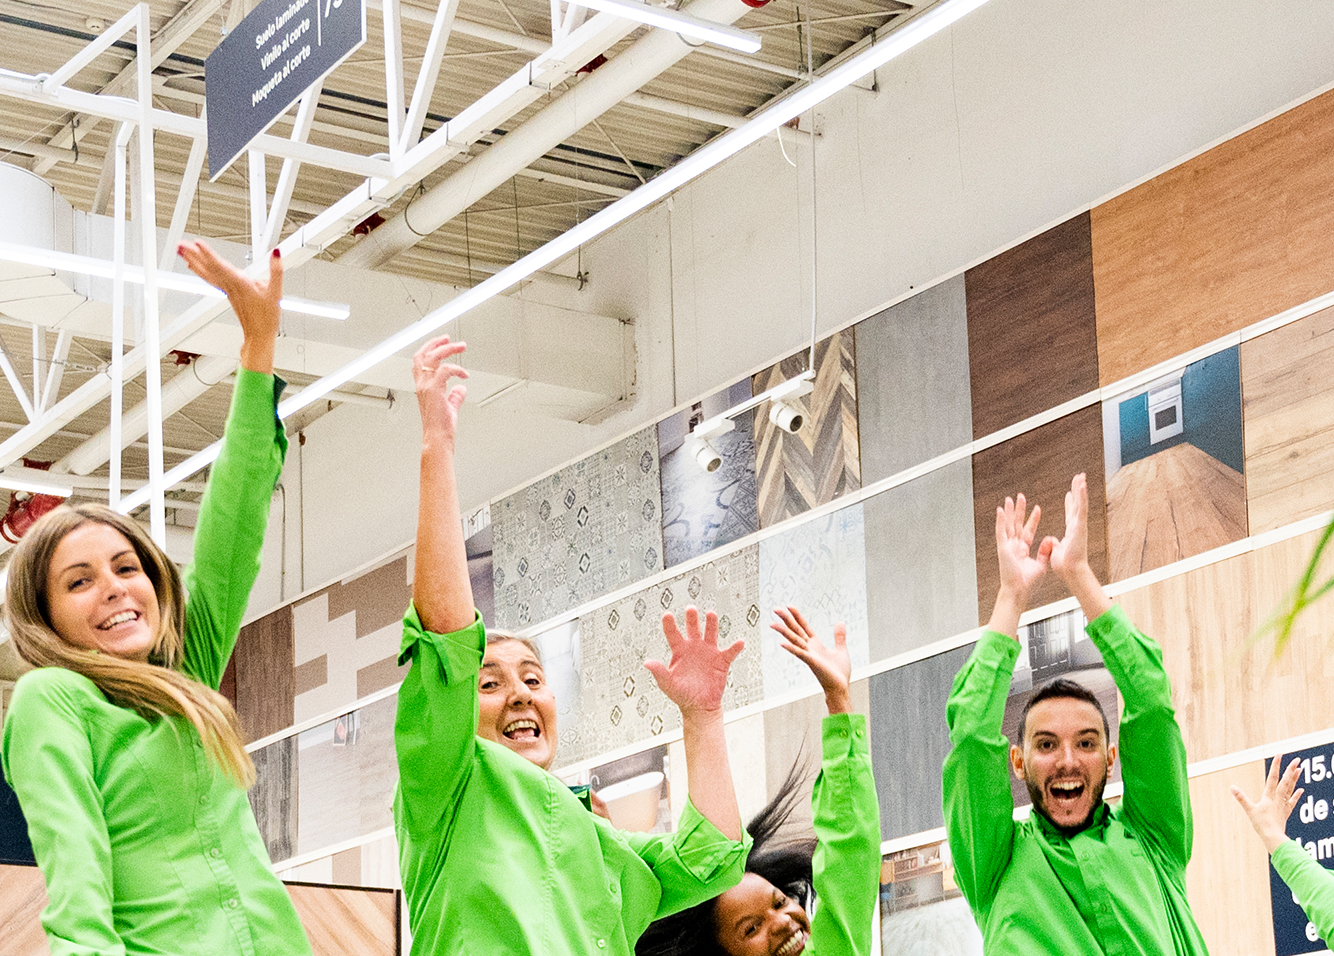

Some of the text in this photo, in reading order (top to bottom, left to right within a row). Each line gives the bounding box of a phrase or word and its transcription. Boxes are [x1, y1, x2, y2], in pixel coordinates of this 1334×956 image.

[256, 24, 275, 49] Suelo
[261, 18, 310, 71] Vinilo al corte
[252, 45, 311, 107] Moqueta al corte
[1299, 795, 1329, 824] de
